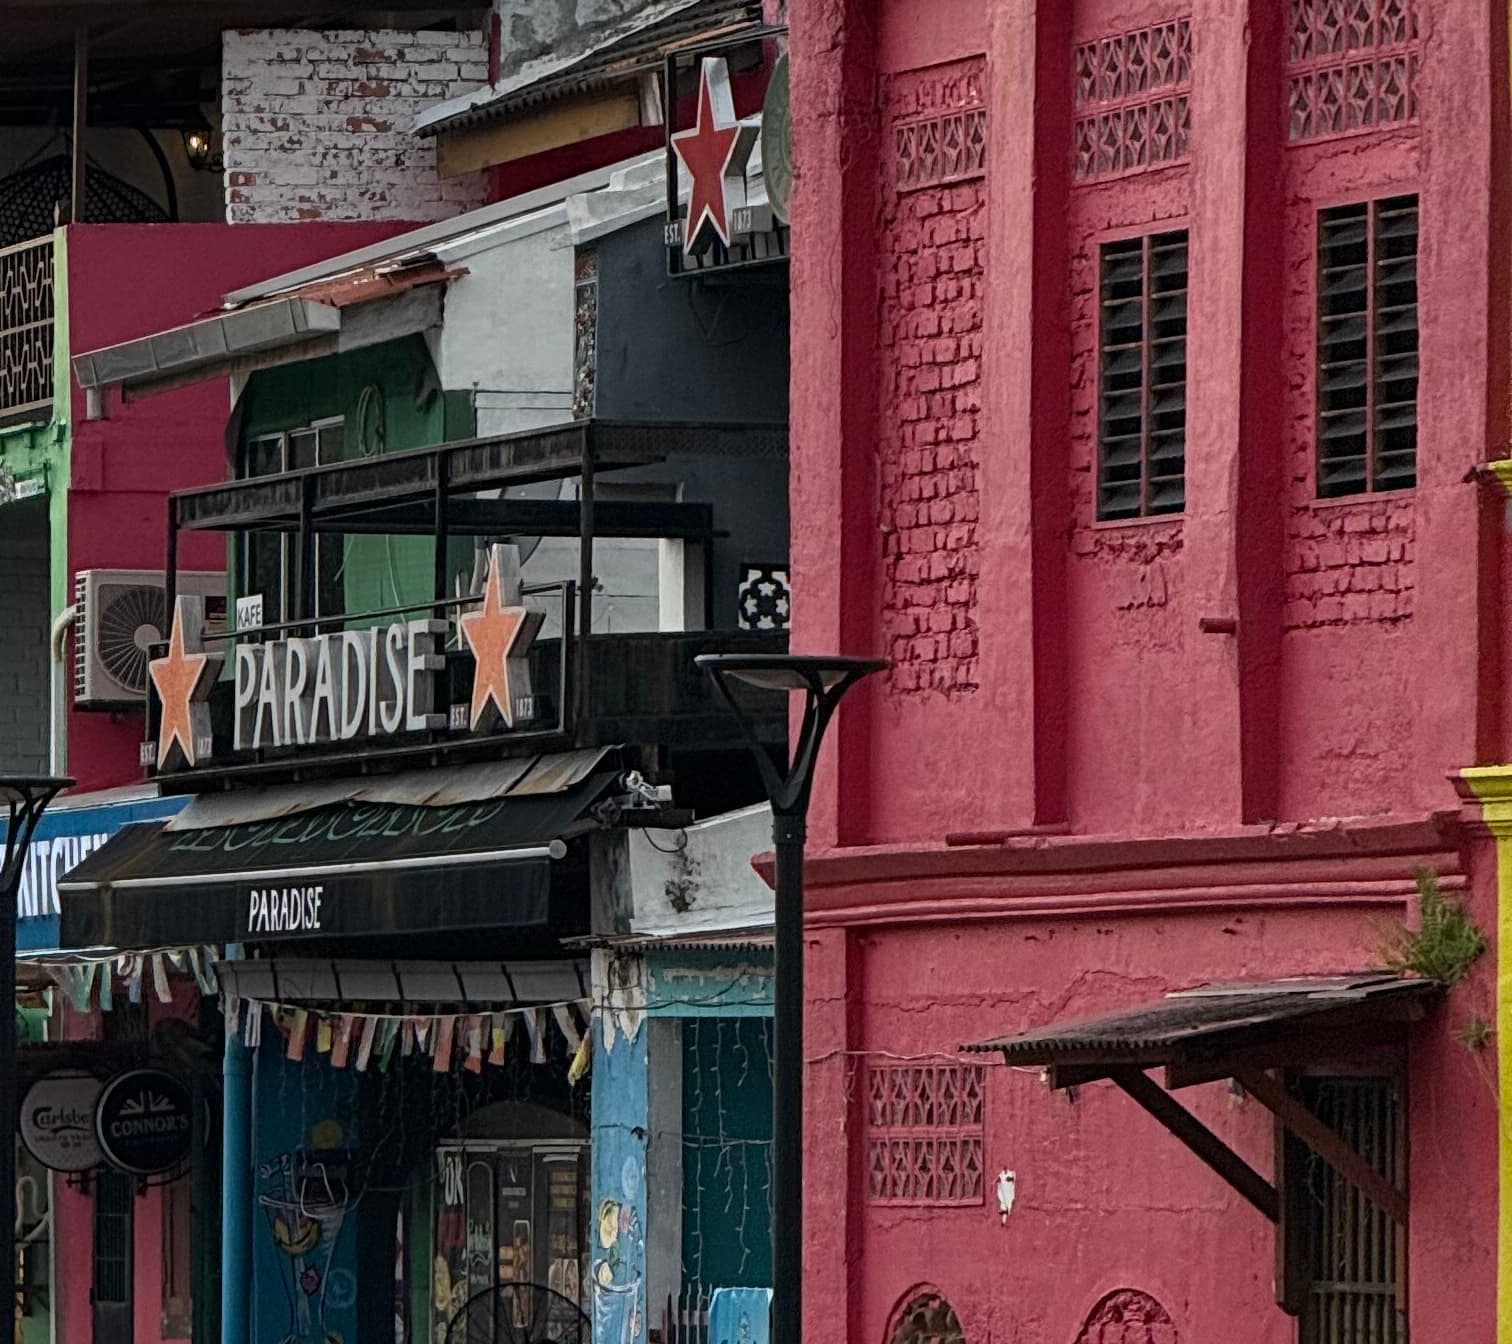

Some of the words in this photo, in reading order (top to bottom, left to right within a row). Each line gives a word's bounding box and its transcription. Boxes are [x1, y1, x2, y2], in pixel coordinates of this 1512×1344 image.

[733, 208, 752, 231] 1873
[237, 605, 263, 627] KAFE
[233, 619, 430, 751] PARADISE
[516, 697, 532, 718] 1873
[248, 886, 323, 932] PARADISE
[32, 1106, 88, 1130] Carlsbe
[111, 1114, 189, 1137] CONNOR'S
